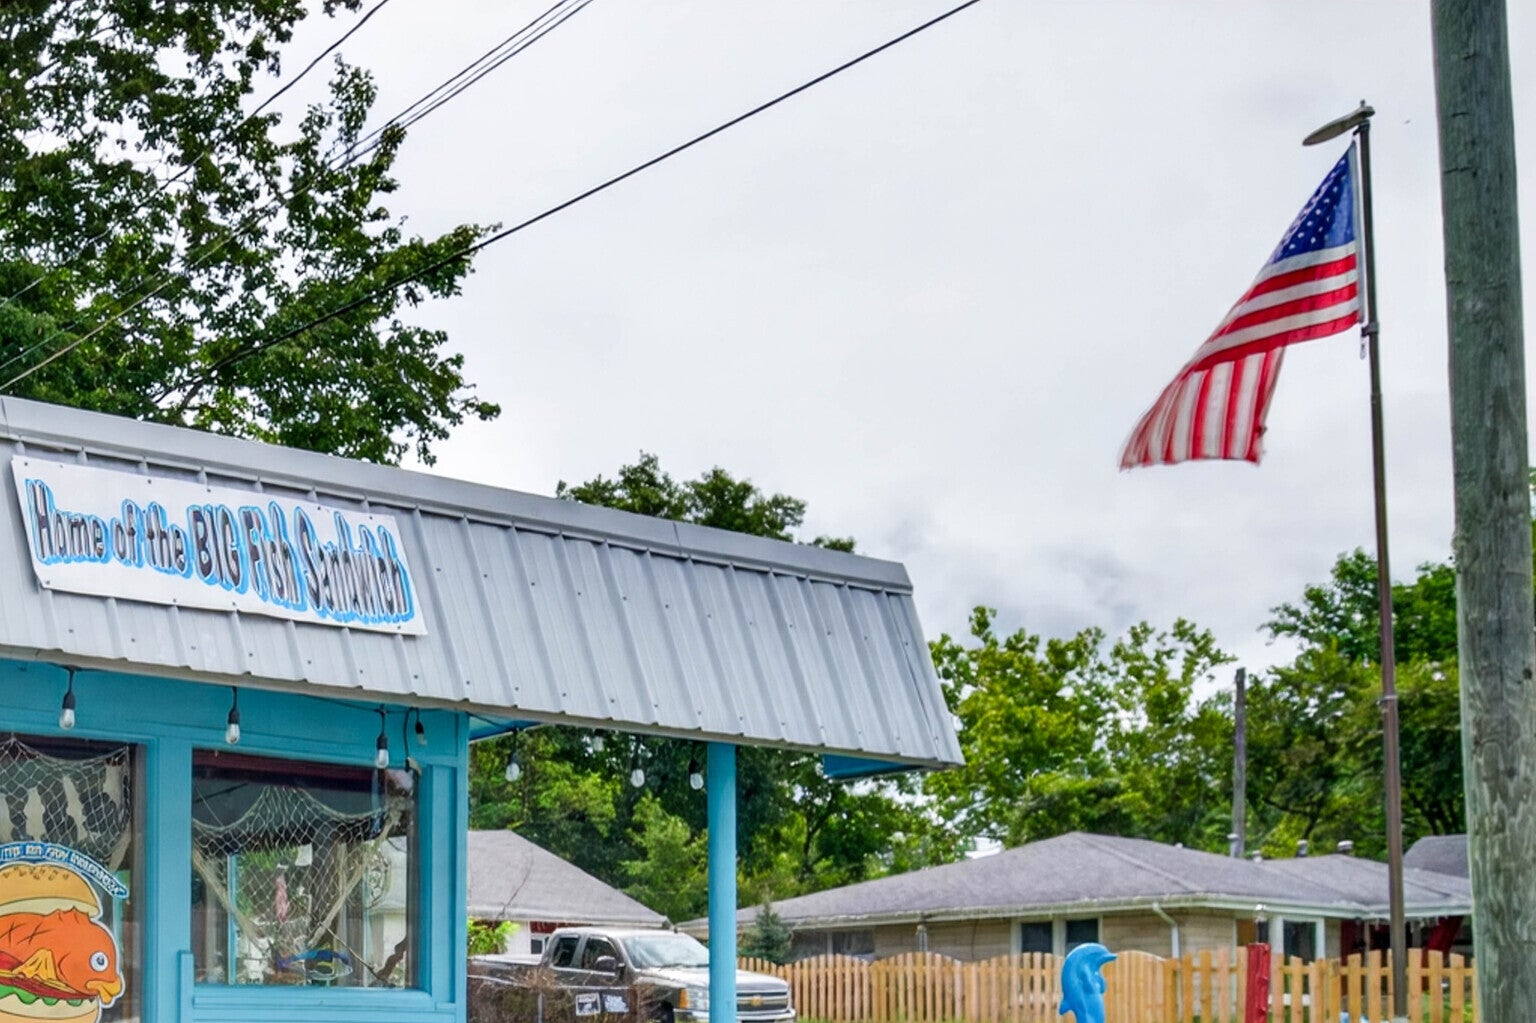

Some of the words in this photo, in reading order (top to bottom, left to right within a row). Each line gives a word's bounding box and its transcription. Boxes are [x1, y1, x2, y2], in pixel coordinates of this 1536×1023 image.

[26, 480, 107, 563] Home
[112, 501, 141, 566] of
[147, 502, 190, 575] the
[189, 505, 244, 592] BIG
[240, 502, 305, 609] Fish
[296, 507, 412, 619] Sandwich
